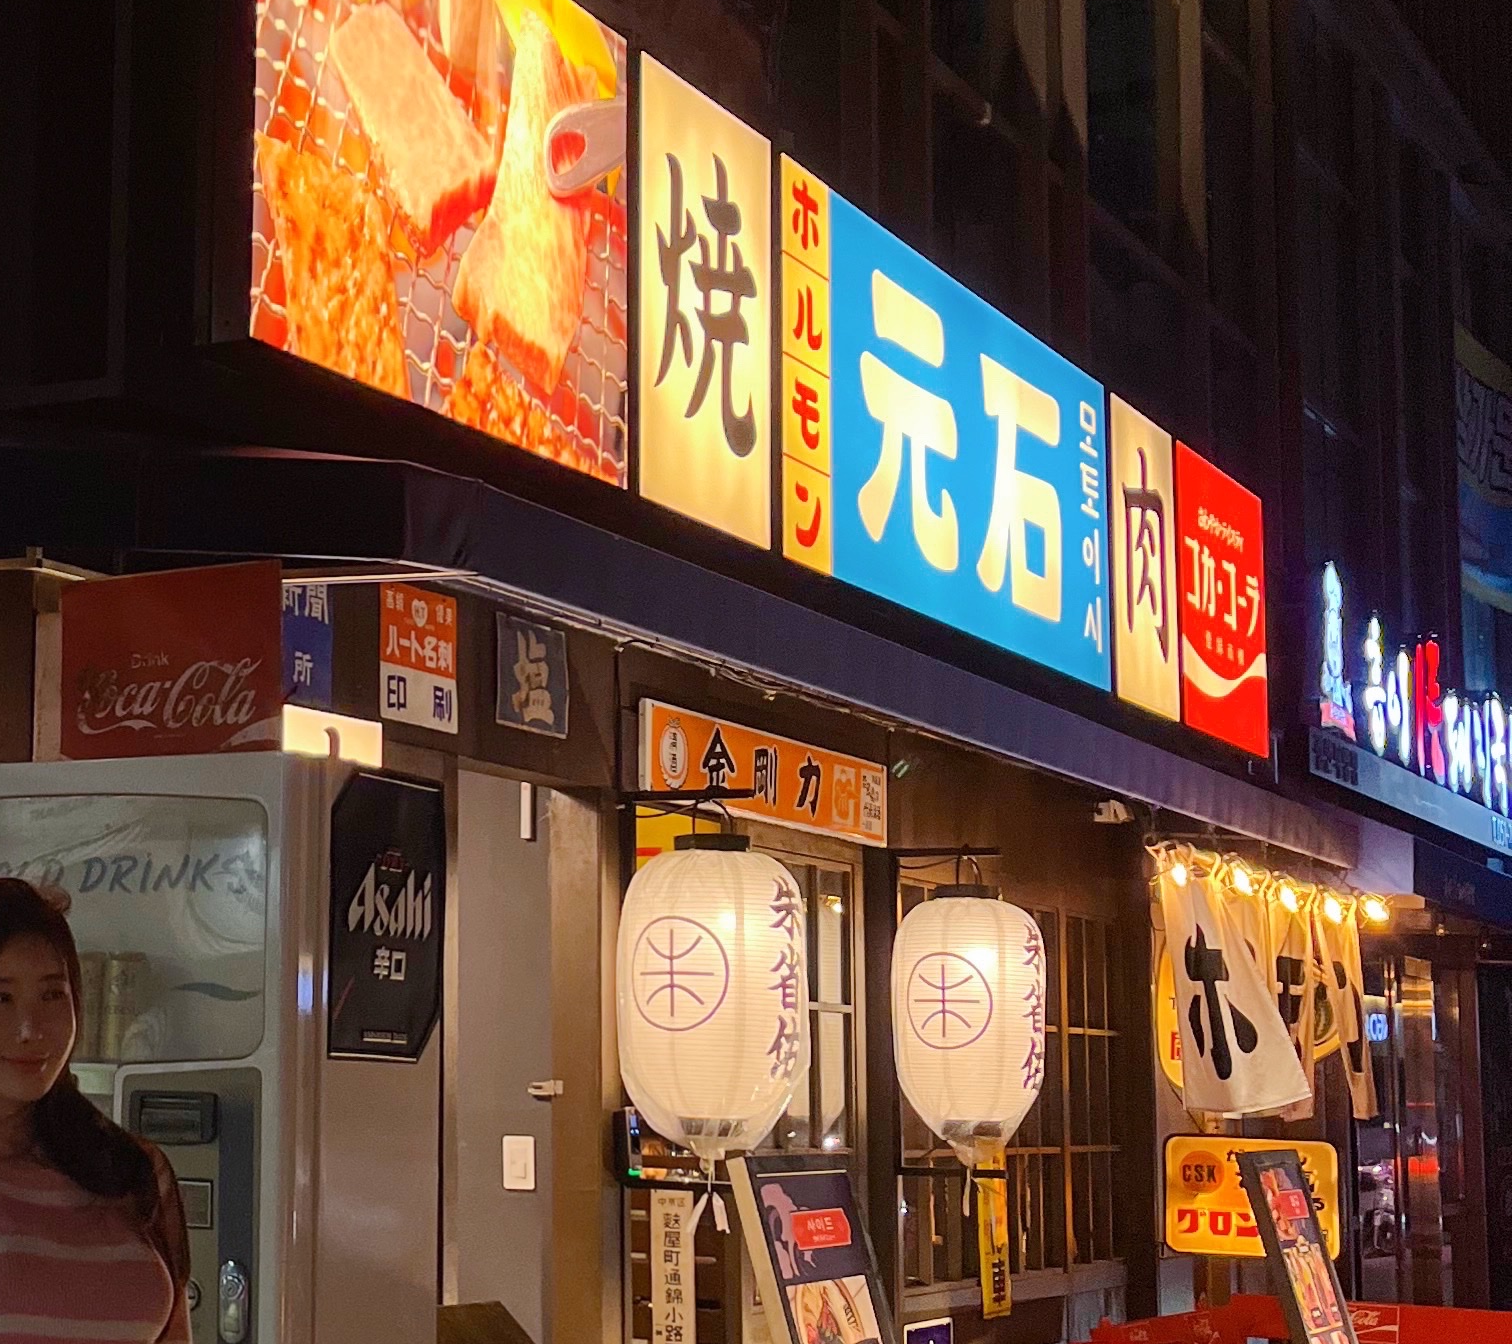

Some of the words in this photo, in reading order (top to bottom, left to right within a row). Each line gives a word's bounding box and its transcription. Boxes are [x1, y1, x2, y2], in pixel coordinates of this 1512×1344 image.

[654, 152, 757, 458] 焼
[791, 178, 822, 549] ホルモン
[858, 268, 1063, 622] 元石
[1078, 400, 1103, 654] 모토이시
[1121, 446, 1169, 663] 肉
[1184, 535, 1260, 638] コカ・コーラ
[293, 652, 314, 687] 所
[387, 623, 453, 674] ハート名刺
[77, 657, 262, 734] Coca-Cola
[387, 674, 453, 724] 印刷
[702, 726, 821, 819] 金剛力
[348, 862, 432, 942] Asahi
[373, 946, 406, 981] 辛口
[1182, 1169, 1217, 1183] CSK
